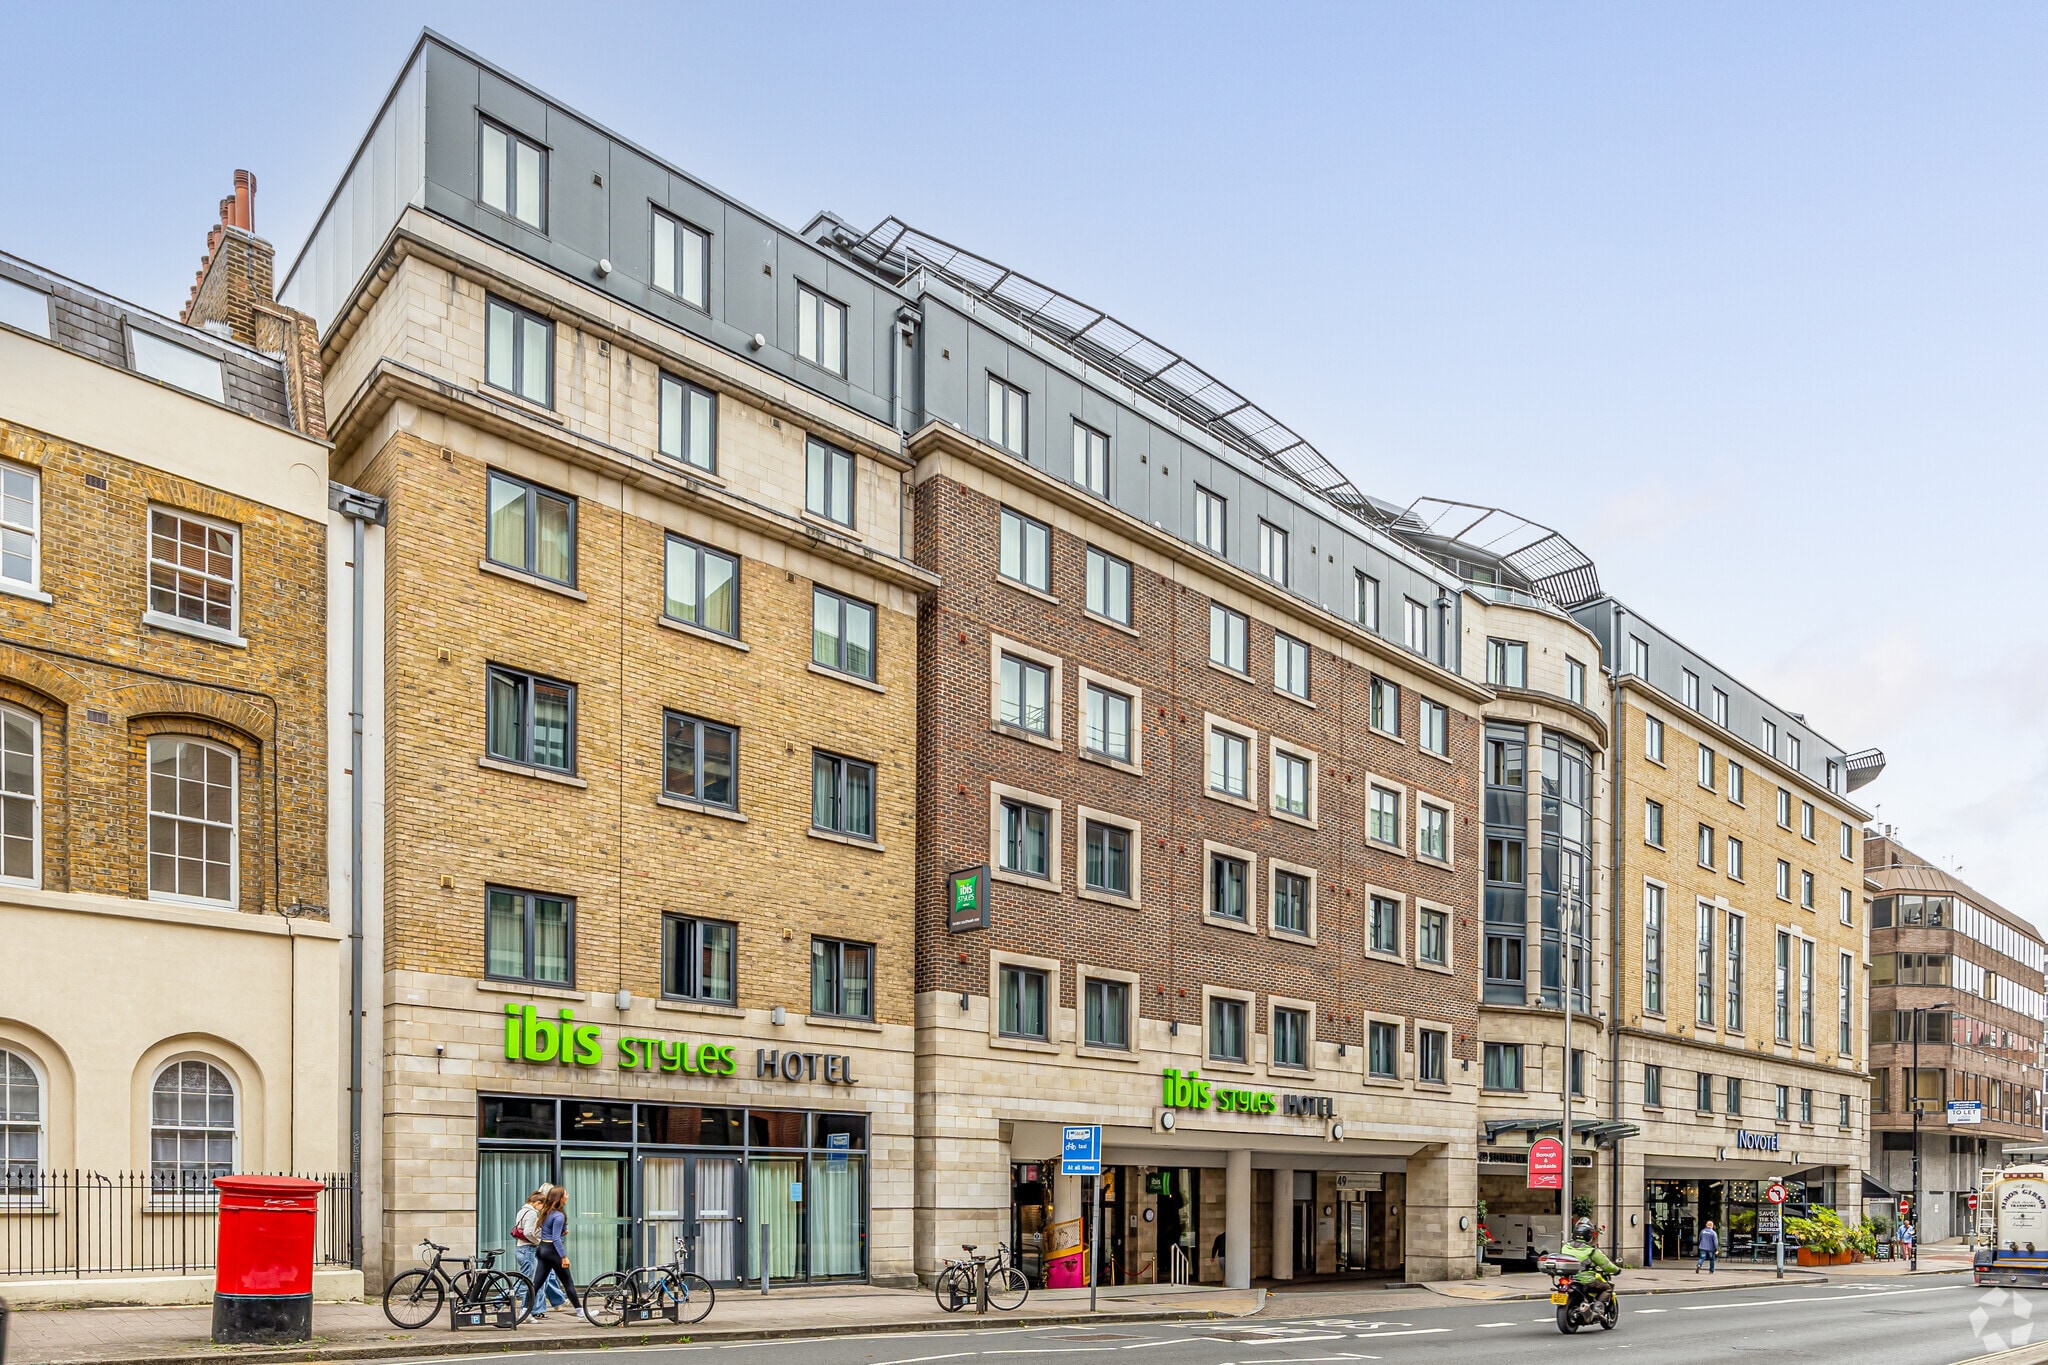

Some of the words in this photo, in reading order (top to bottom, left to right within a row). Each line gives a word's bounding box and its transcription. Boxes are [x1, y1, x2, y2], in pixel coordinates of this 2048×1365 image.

[960, 883, 973, 895] ibis
[504, 1003, 603, 1066] ibis
[756, 1048, 859, 1084] HOTEL
[1162, 1068, 1213, 1110] ibis
[1282, 1093, 1337, 1118] HOTEL
[1737, 1129, 1782, 1152] NOVOTEL
[1337, 1175, 1347, 1186] 49
[2001, 1189, 2019, 1210] SIMON
[2021, 1189, 2047, 1210] GIBSON
